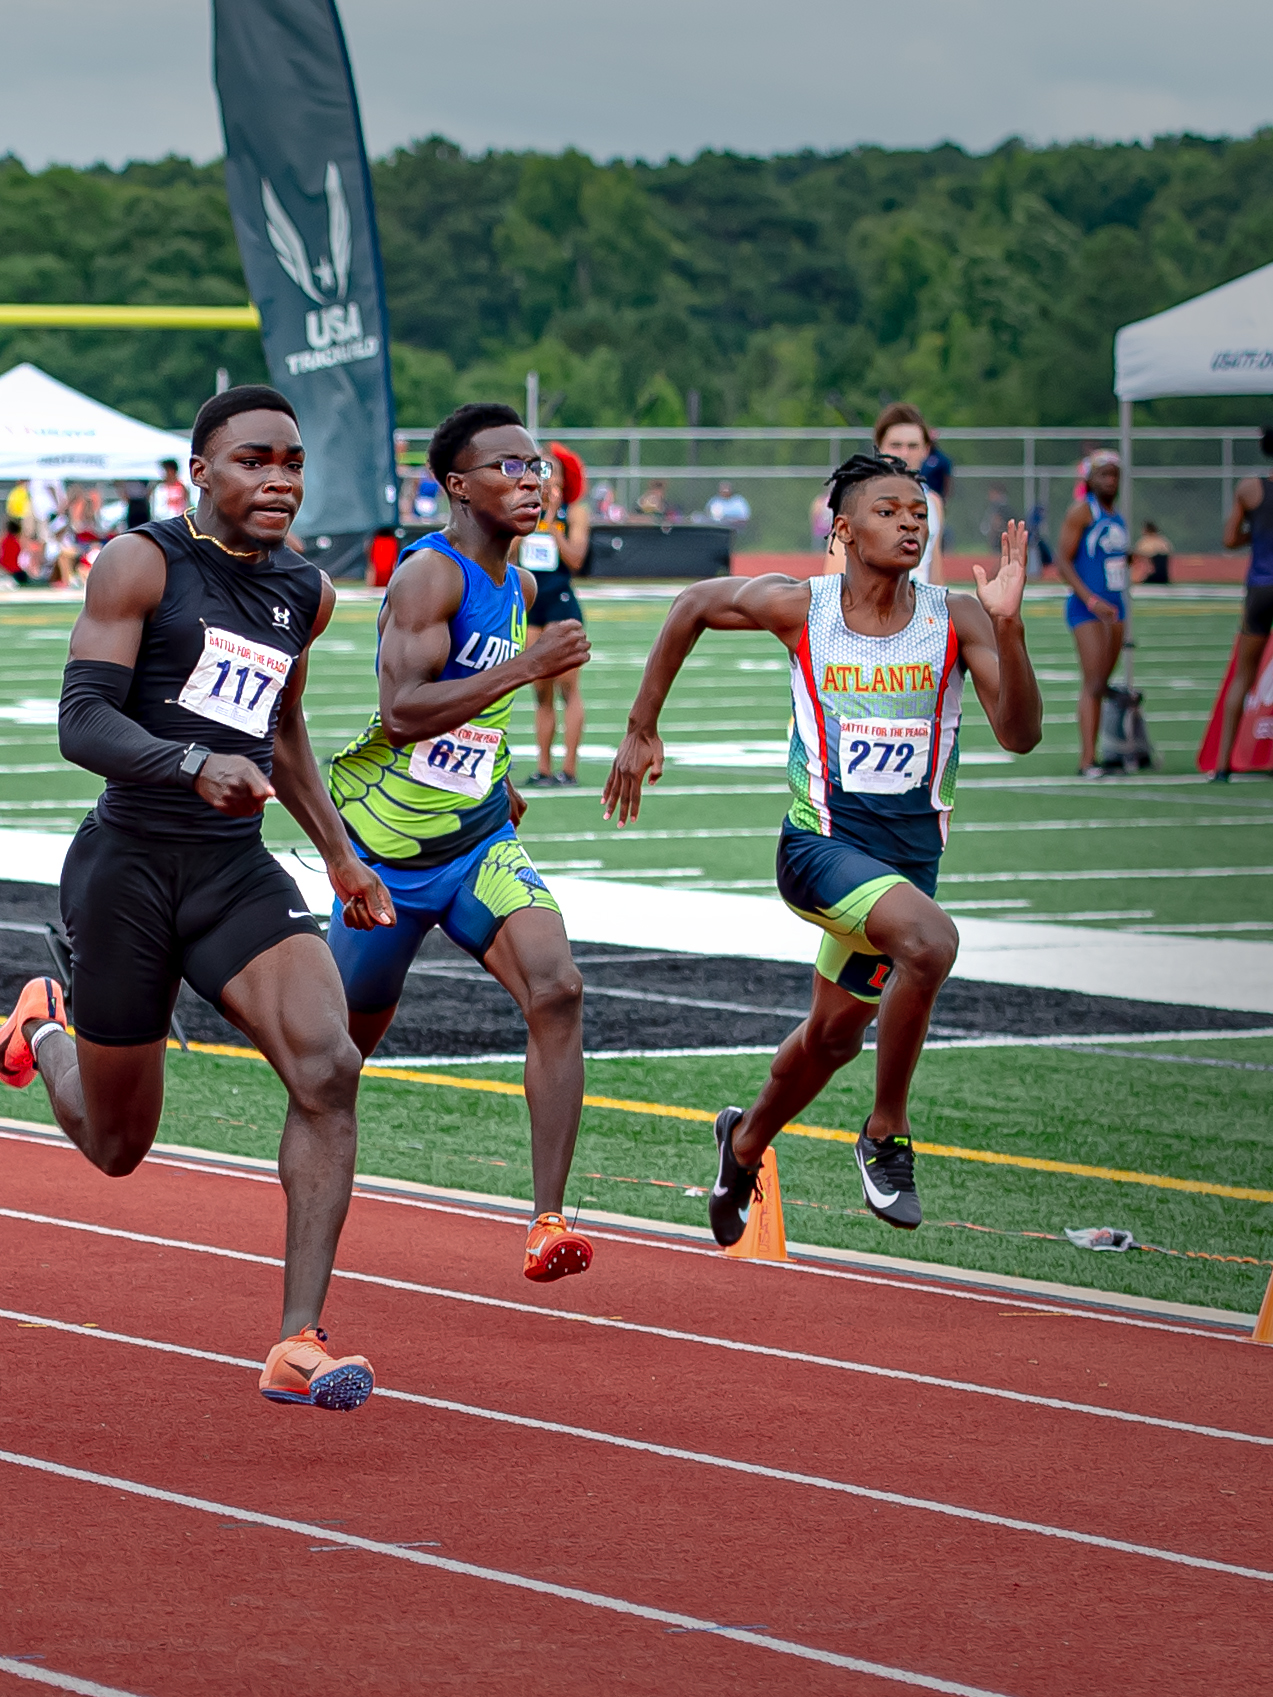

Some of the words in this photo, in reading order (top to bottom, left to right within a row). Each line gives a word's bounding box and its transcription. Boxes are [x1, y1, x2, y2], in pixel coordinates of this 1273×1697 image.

[305, 302, 362, 350] USA
[209, 635, 236, 653] BATTLE
[236, 645, 252, 660] FOR
[253, 652, 266, 665] THE
[266, 657, 287, 675] PEACH
[208, 660, 273, 711] 117
[822, 664, 935, 693] ATLANTA
[457, 728, 472, 740] FOR
[840, 723, 869, 734] BATTLE
[871, 726, 888, 737] FOR
[890, 728, 903, 737] THE
[905, 727, 929, 738] PEACH
[428, 739, 487, 779] 677
[847, 740, 915, 778] 272
